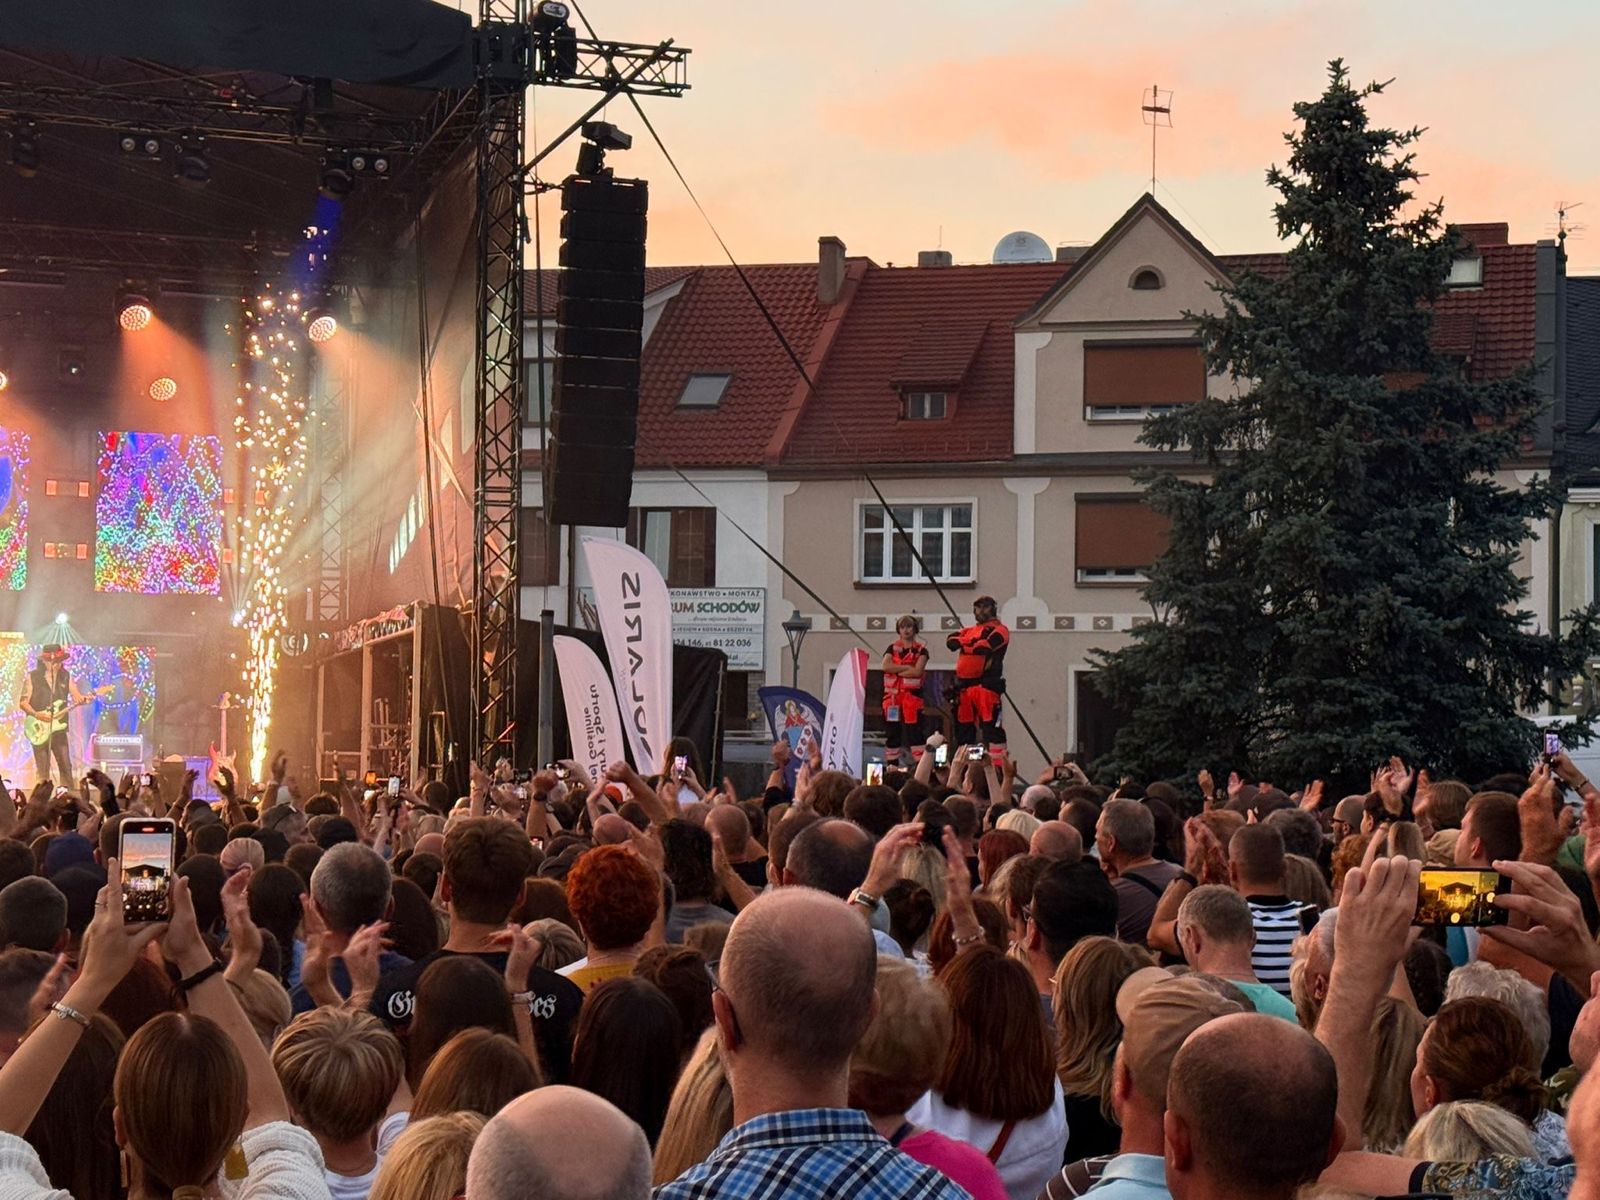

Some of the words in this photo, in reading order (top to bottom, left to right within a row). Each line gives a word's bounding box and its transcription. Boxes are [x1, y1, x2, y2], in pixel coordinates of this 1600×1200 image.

[696, 599, 760, 614] SCHODÓW
[713, 639, 723, 647] 81
[725, 639, 735, 647] 22
[736, 639, 752, 647] 036
